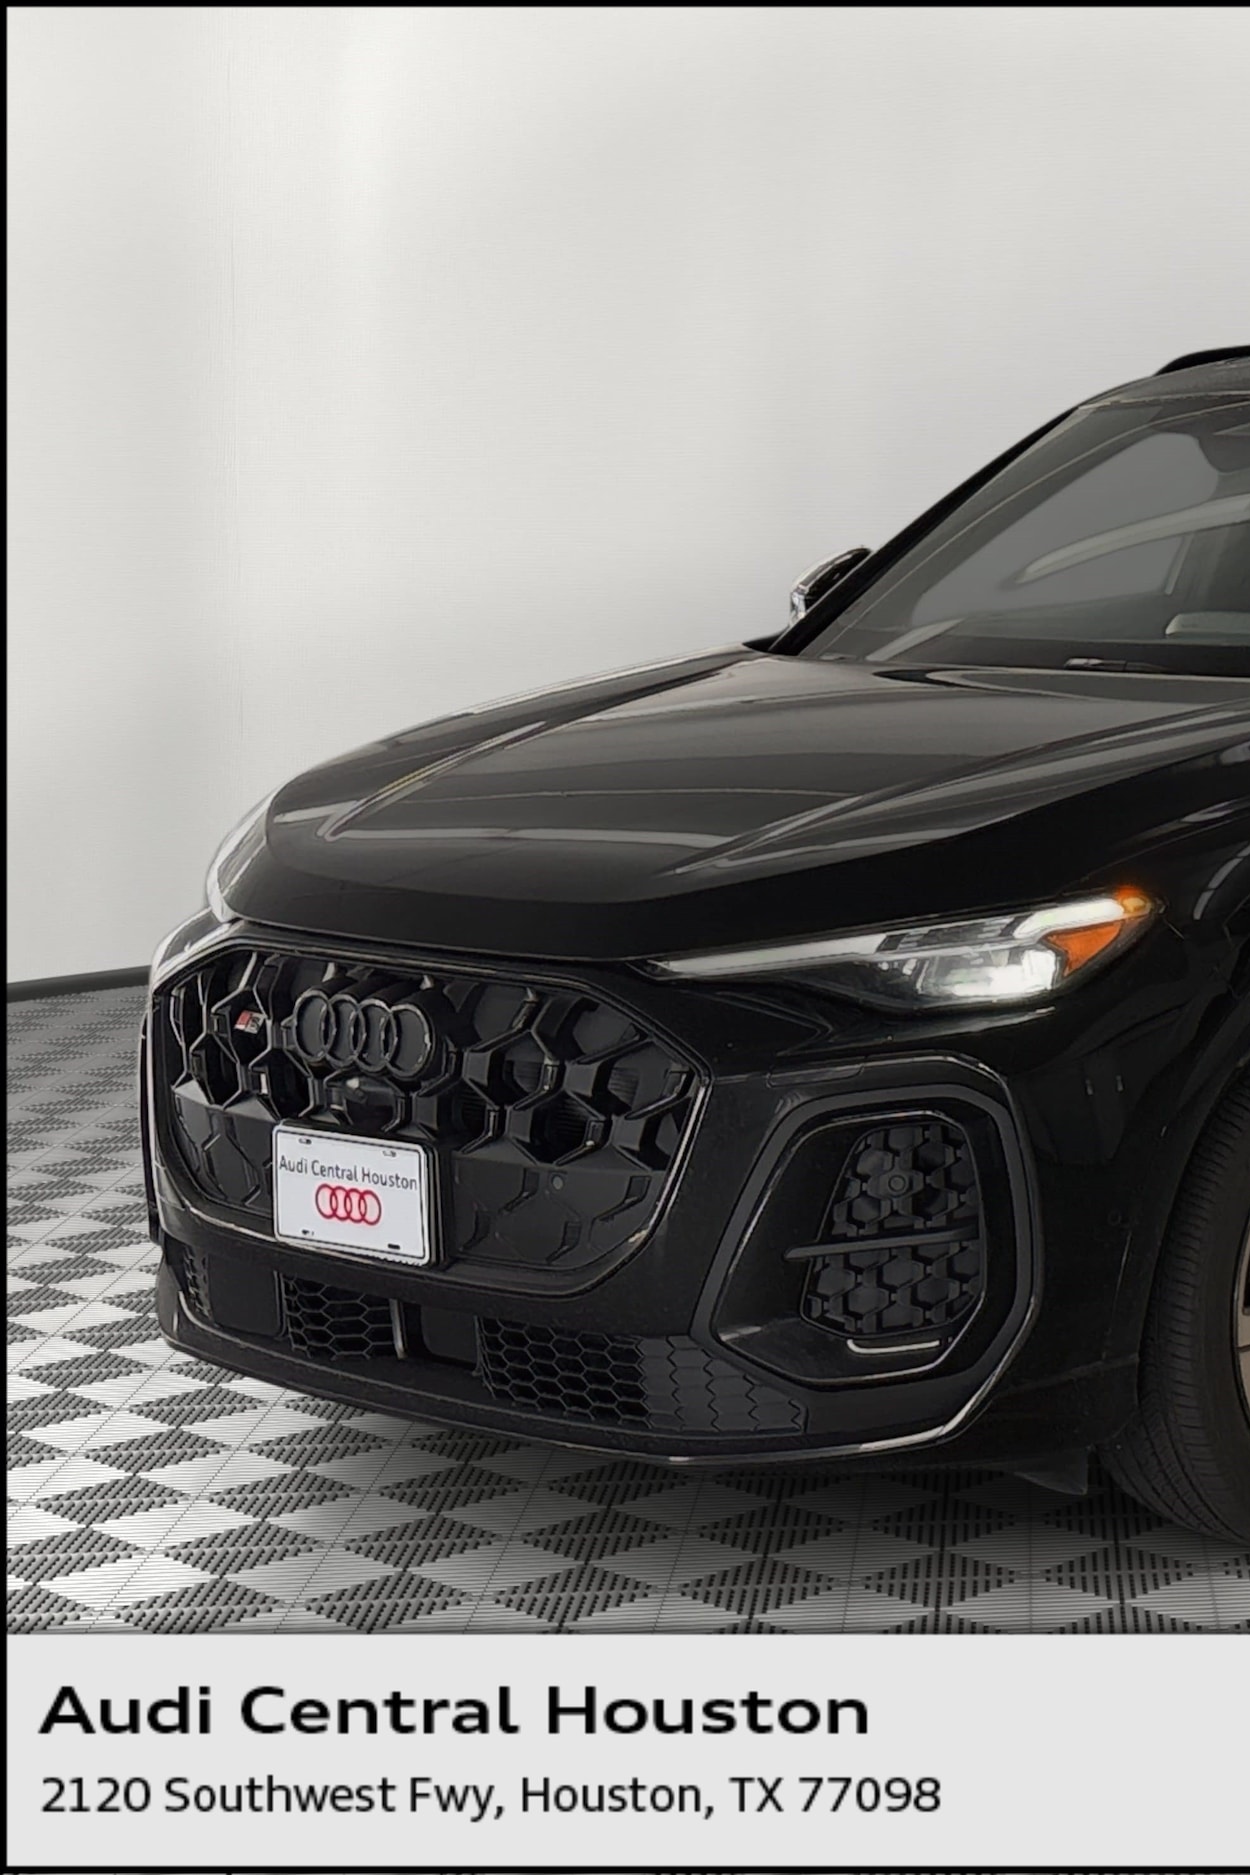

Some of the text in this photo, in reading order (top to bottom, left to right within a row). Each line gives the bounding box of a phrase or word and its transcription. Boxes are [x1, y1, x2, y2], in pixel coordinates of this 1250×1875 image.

[279, 1155, 418, 1191] Audi Central Houston
